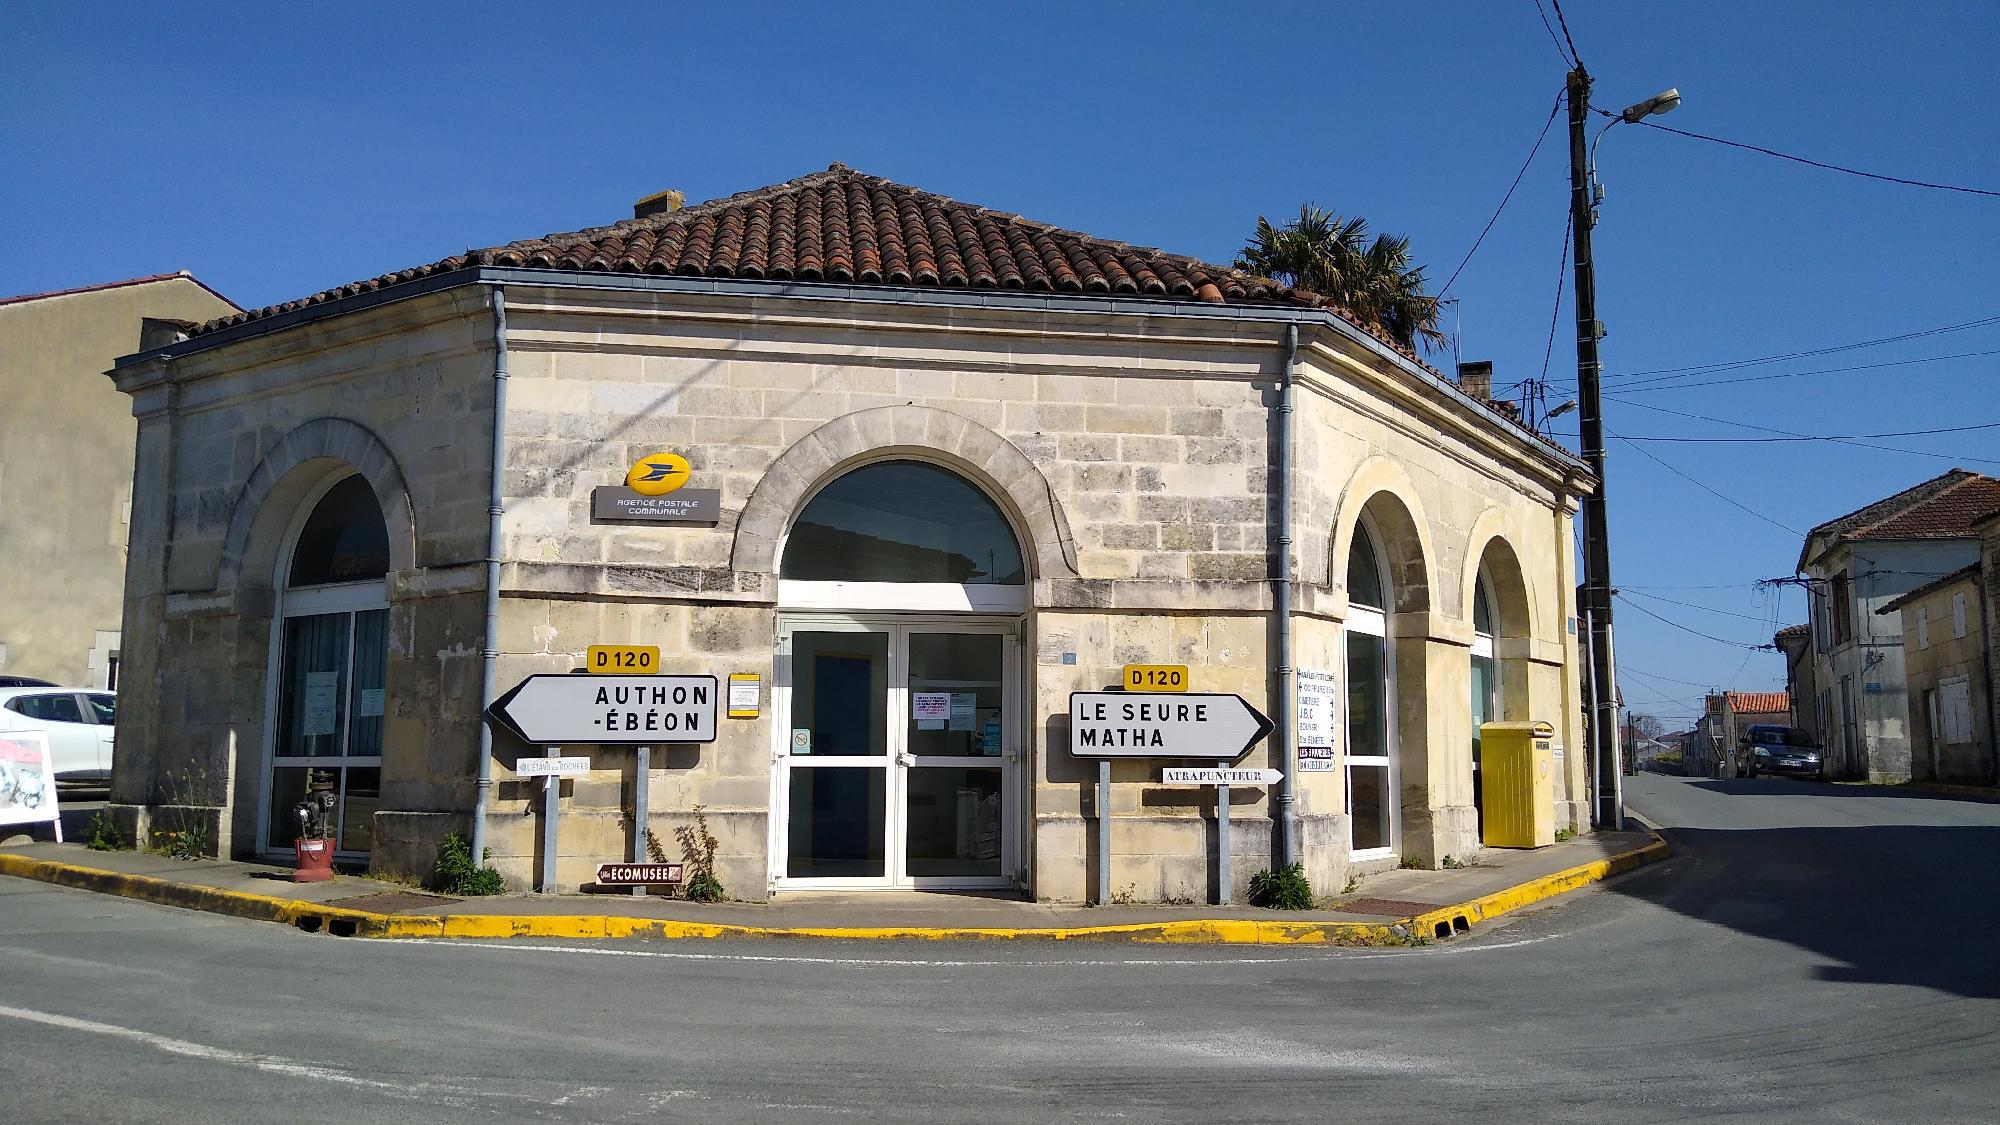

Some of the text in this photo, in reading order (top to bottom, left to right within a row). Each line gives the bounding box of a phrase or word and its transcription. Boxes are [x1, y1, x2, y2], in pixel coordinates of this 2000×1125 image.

[616, 499, 699, 508] AGENCE POSTALE
[628, 507, 687, 516] COMMUNALE
[597, 651, 651, 668] D 120
[1132, 670, 1181, 686] D 120
[595, 686, 707, 705] AUTHON
[594, 709, 699, 731] -ÉBÉON
[1080, 702, 1208, 722] LE SEURE
[1080, 728, 1164, 747] MATHA
[1166, 771, 1262, 781] ATRAPUNCTEUR
